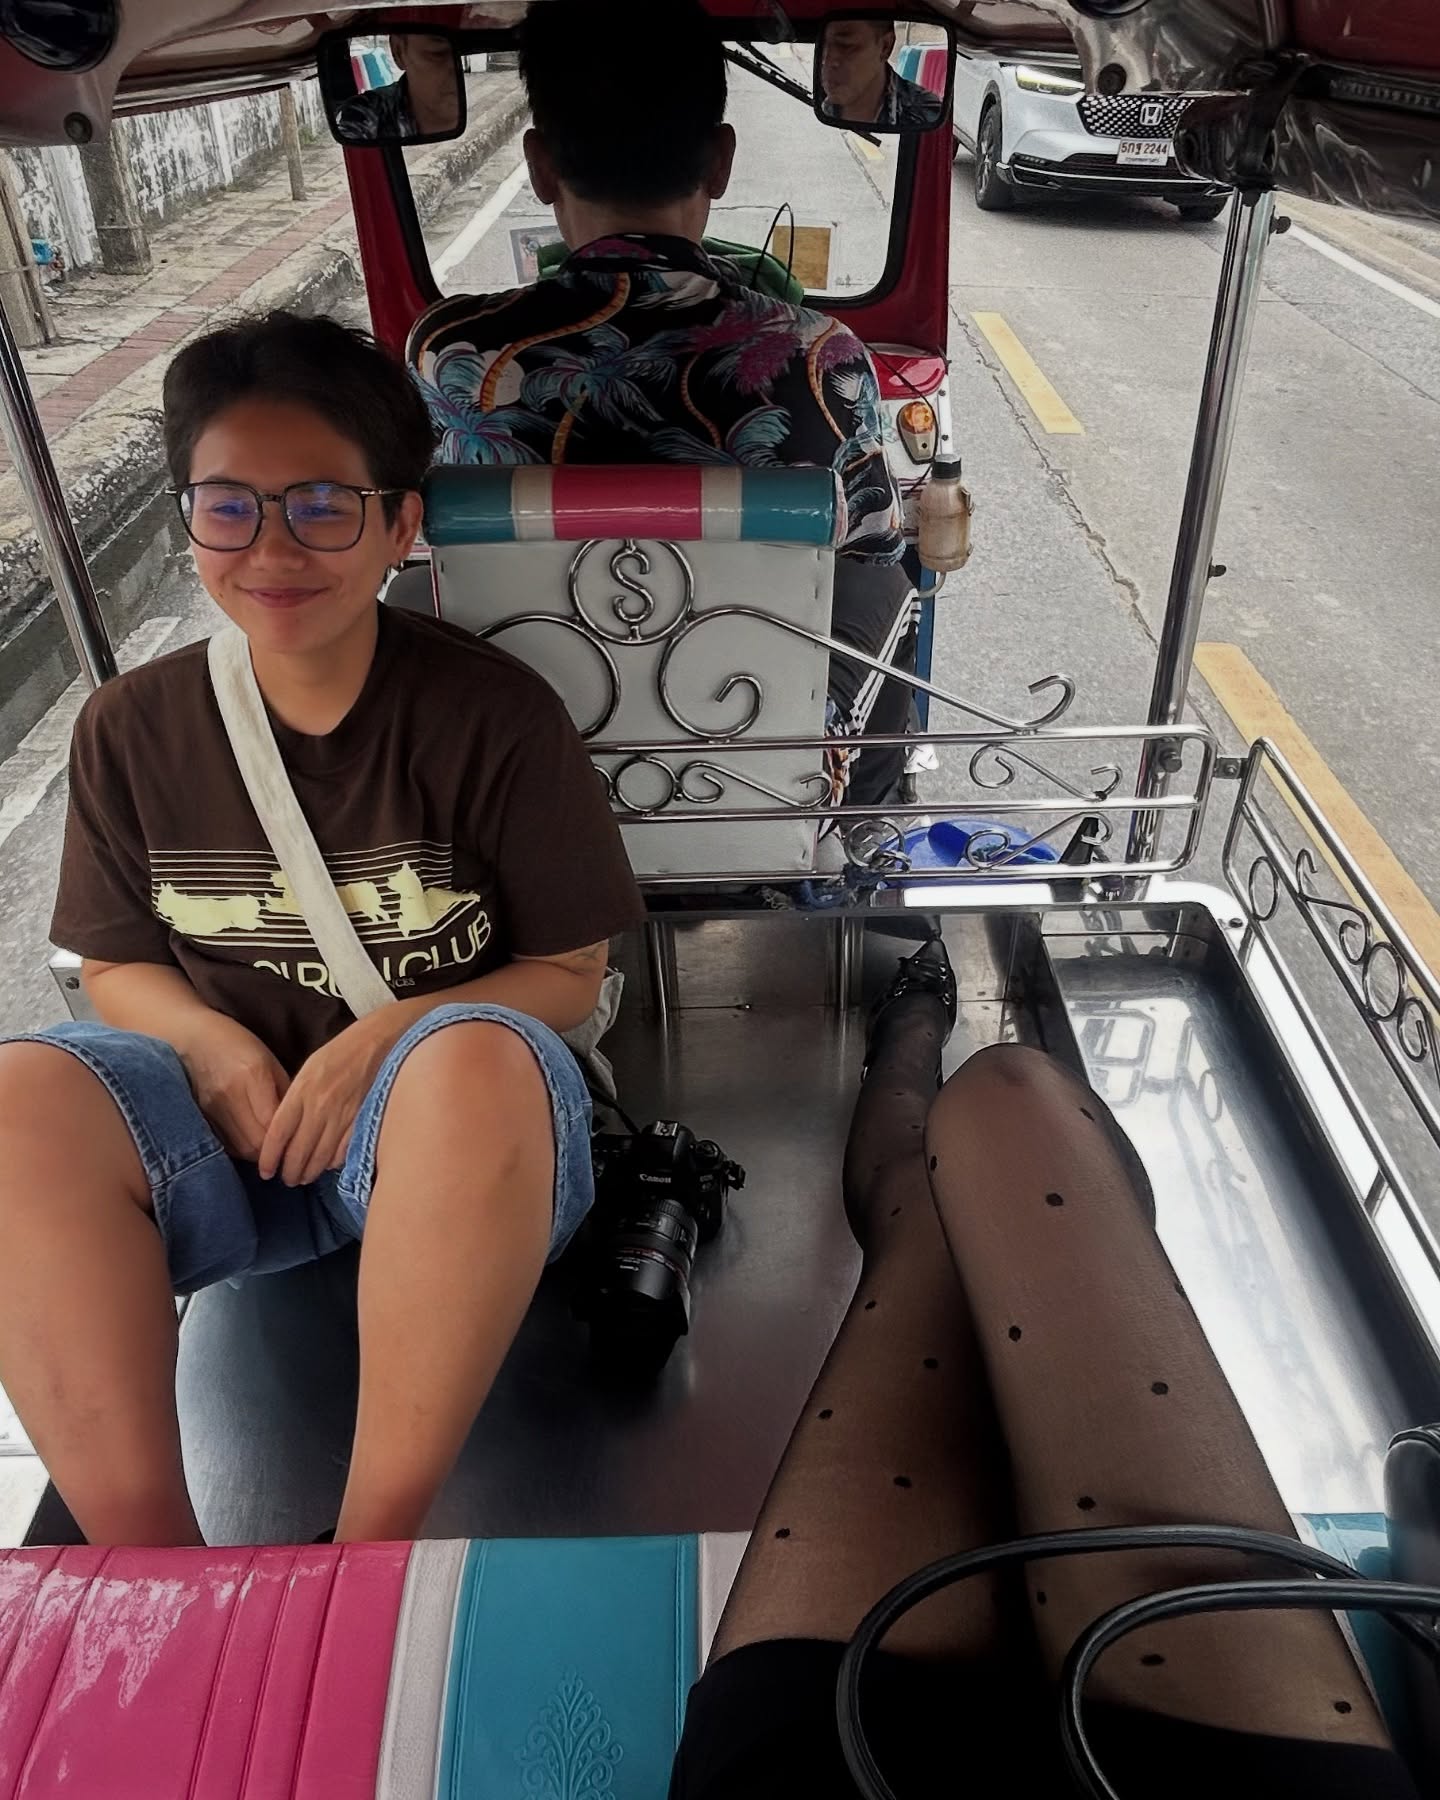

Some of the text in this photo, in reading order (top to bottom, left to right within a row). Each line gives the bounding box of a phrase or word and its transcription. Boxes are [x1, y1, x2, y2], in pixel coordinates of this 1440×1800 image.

[1143, 143, 1168, 155] 2244
[398, 910, 491, 978] CLUB
[639, 1173, 672, 1184] Canon
